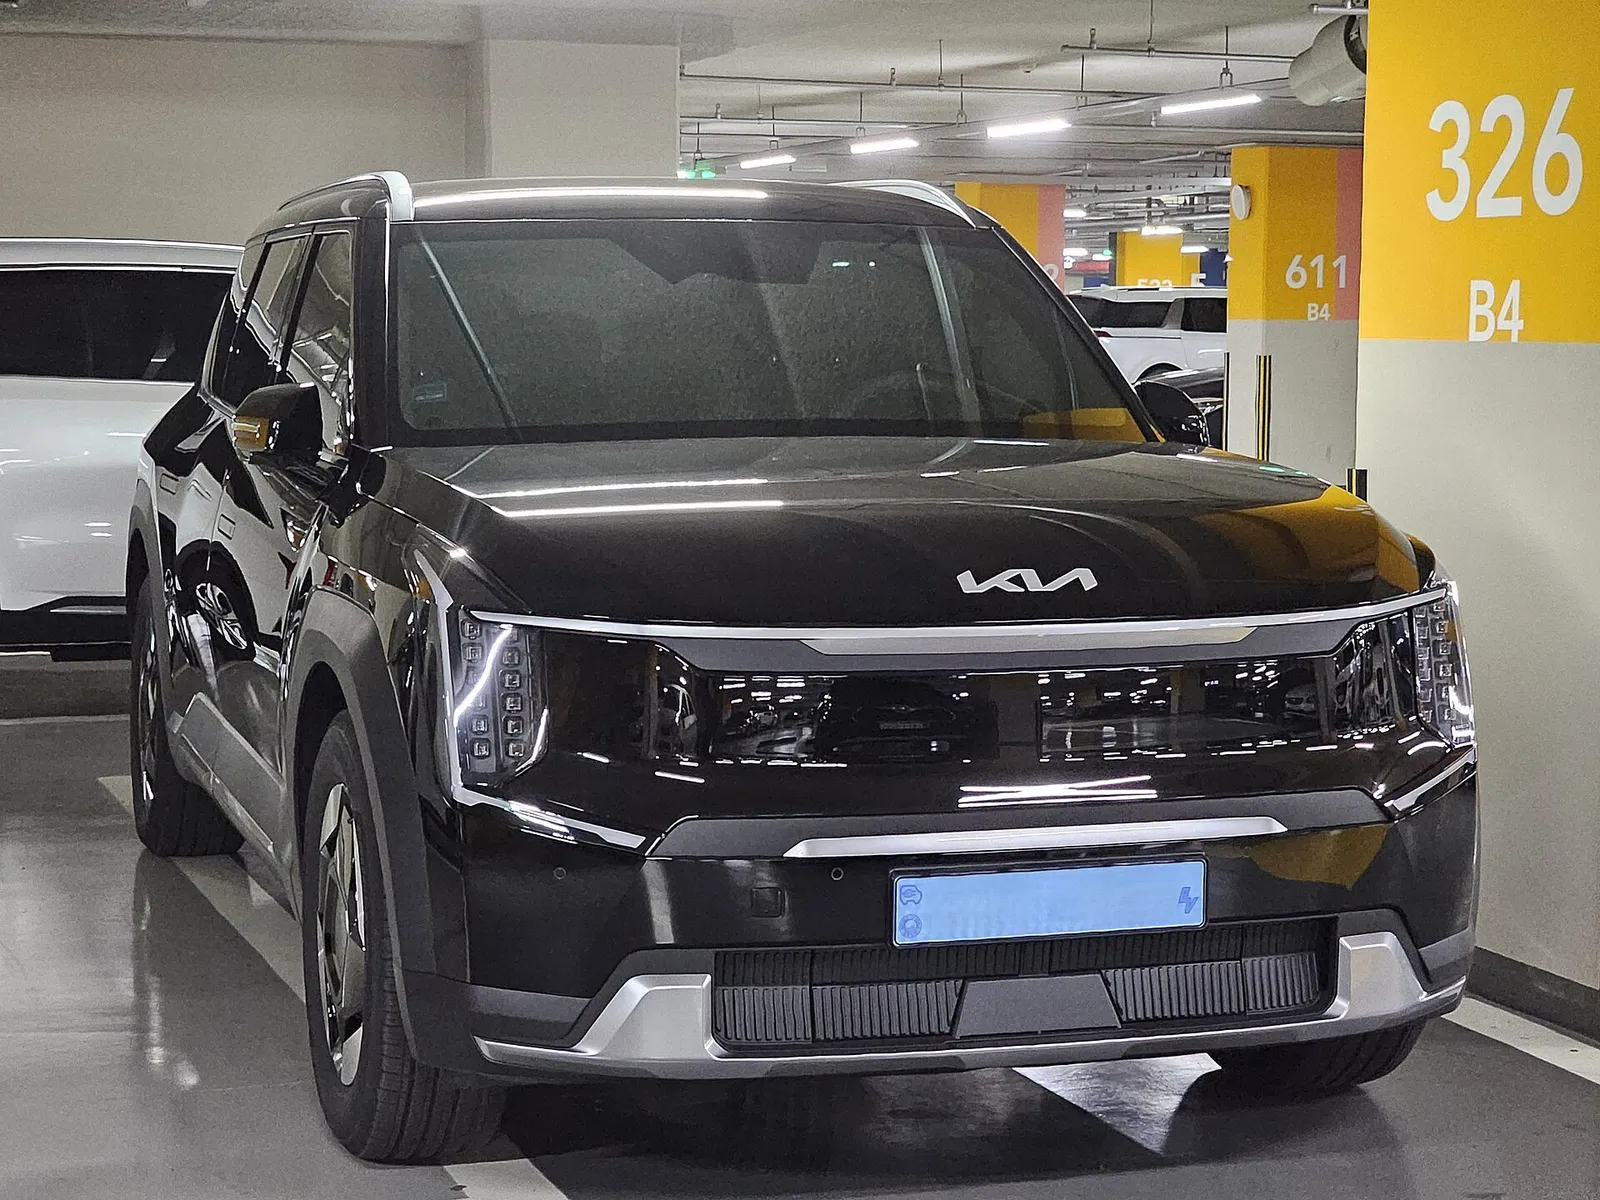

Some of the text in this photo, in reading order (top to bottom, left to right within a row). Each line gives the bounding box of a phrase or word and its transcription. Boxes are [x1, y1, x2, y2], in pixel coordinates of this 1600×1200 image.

[1425, 87, 1583, 222] 326
[1285, 254, 1347, 289] 611
[1307, 302, 1331, 321] B4
[1468, 279, 1524, 343] B4
